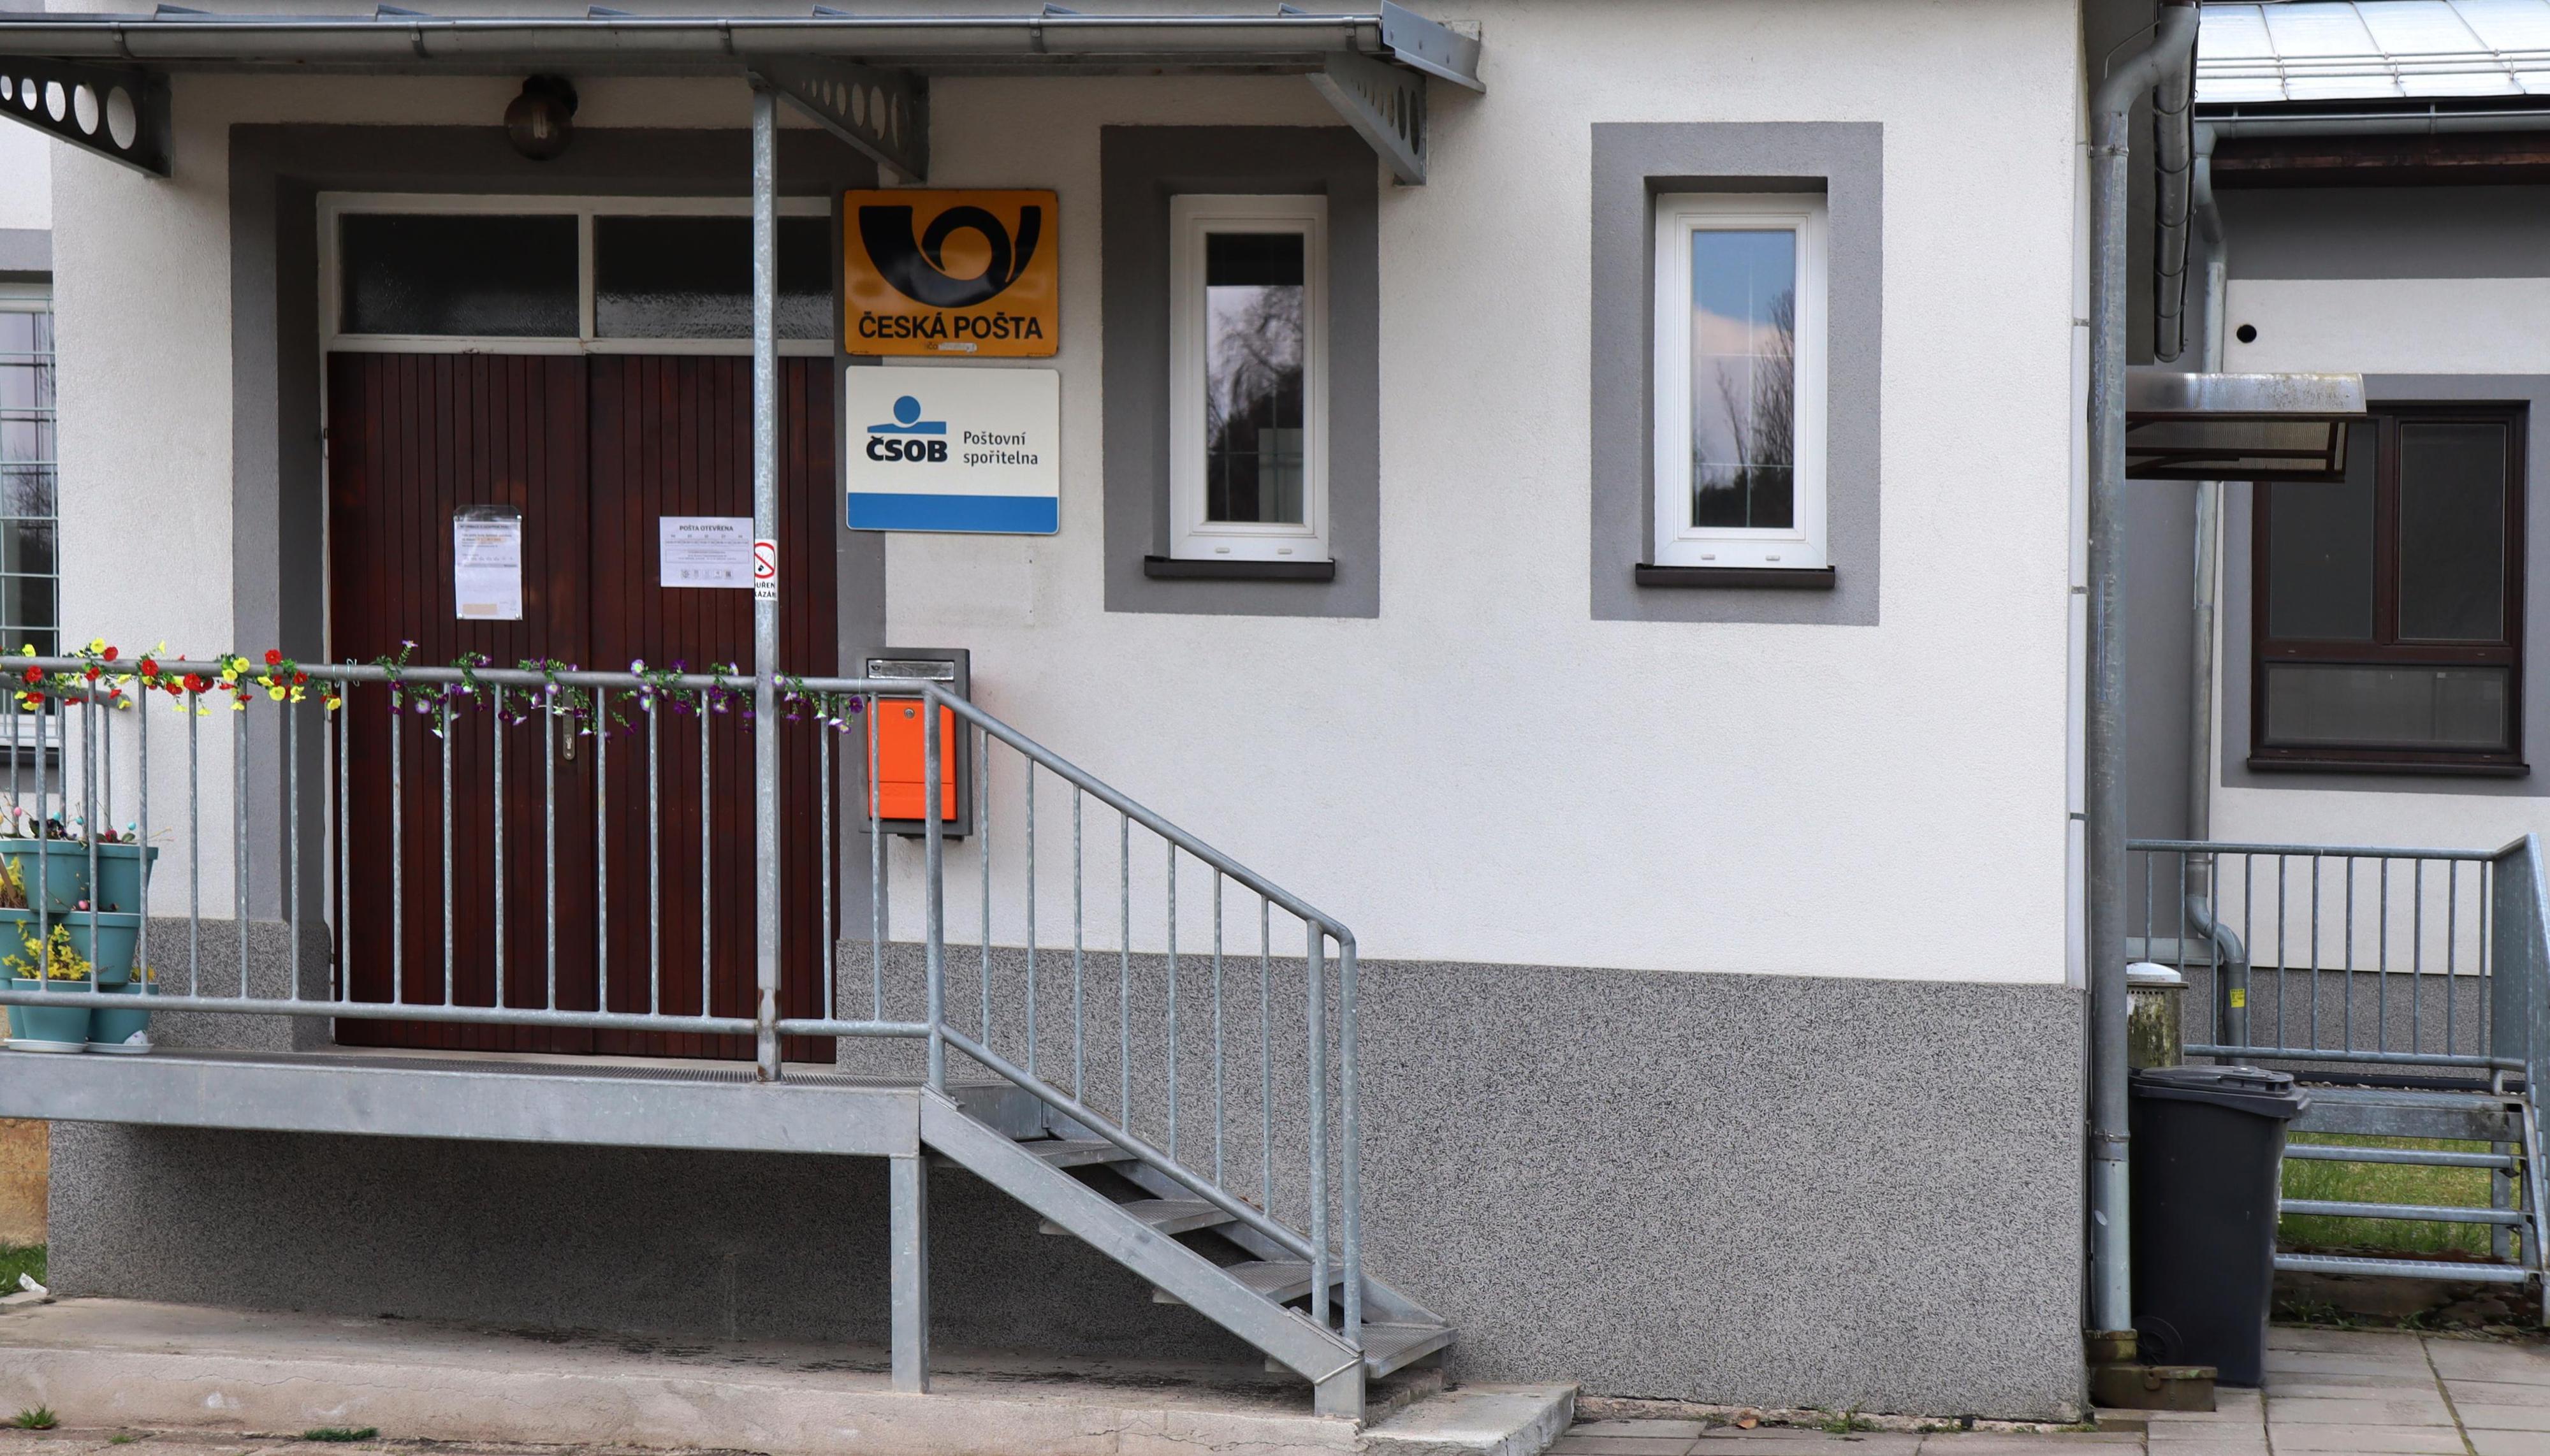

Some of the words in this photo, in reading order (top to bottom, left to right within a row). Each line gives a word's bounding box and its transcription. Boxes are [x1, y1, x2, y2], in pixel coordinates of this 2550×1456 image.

[859, 311, 948, 339] ČESKÁ
[954, 312, 1043, 339] POŠTA
[866, 435, 948, 463] ČSOB
[963, 431, 1026, 446] Poštovní
[963, 450, 1038, 467] spořitelna
